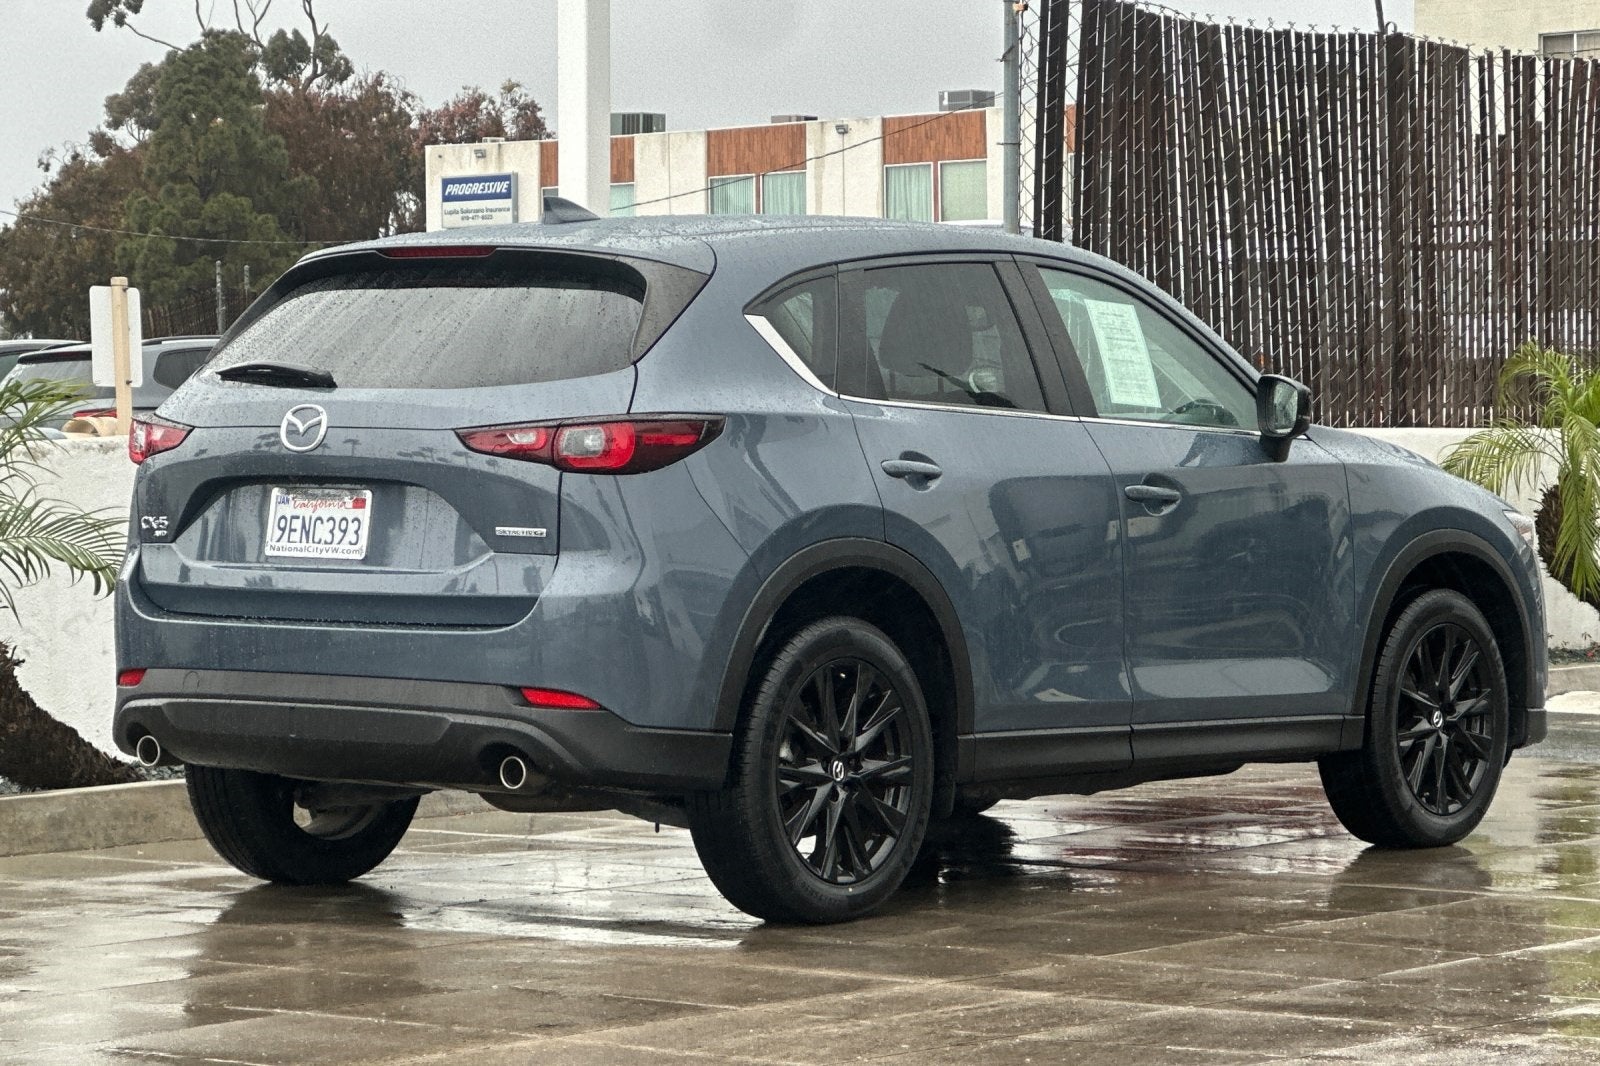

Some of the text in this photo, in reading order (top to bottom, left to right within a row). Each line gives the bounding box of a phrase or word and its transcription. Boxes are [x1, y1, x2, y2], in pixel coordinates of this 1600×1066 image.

[445, 181, 510, 196] PROGRESSIVE
[277, 495, 289, 504] JAN
[293, 497, 346, 513] California
[141, 515, 169, 529] CX-5
[275, 515, 361, 546] 9ENC393
[269, 544, 362, 556] NationalCityVW.com
